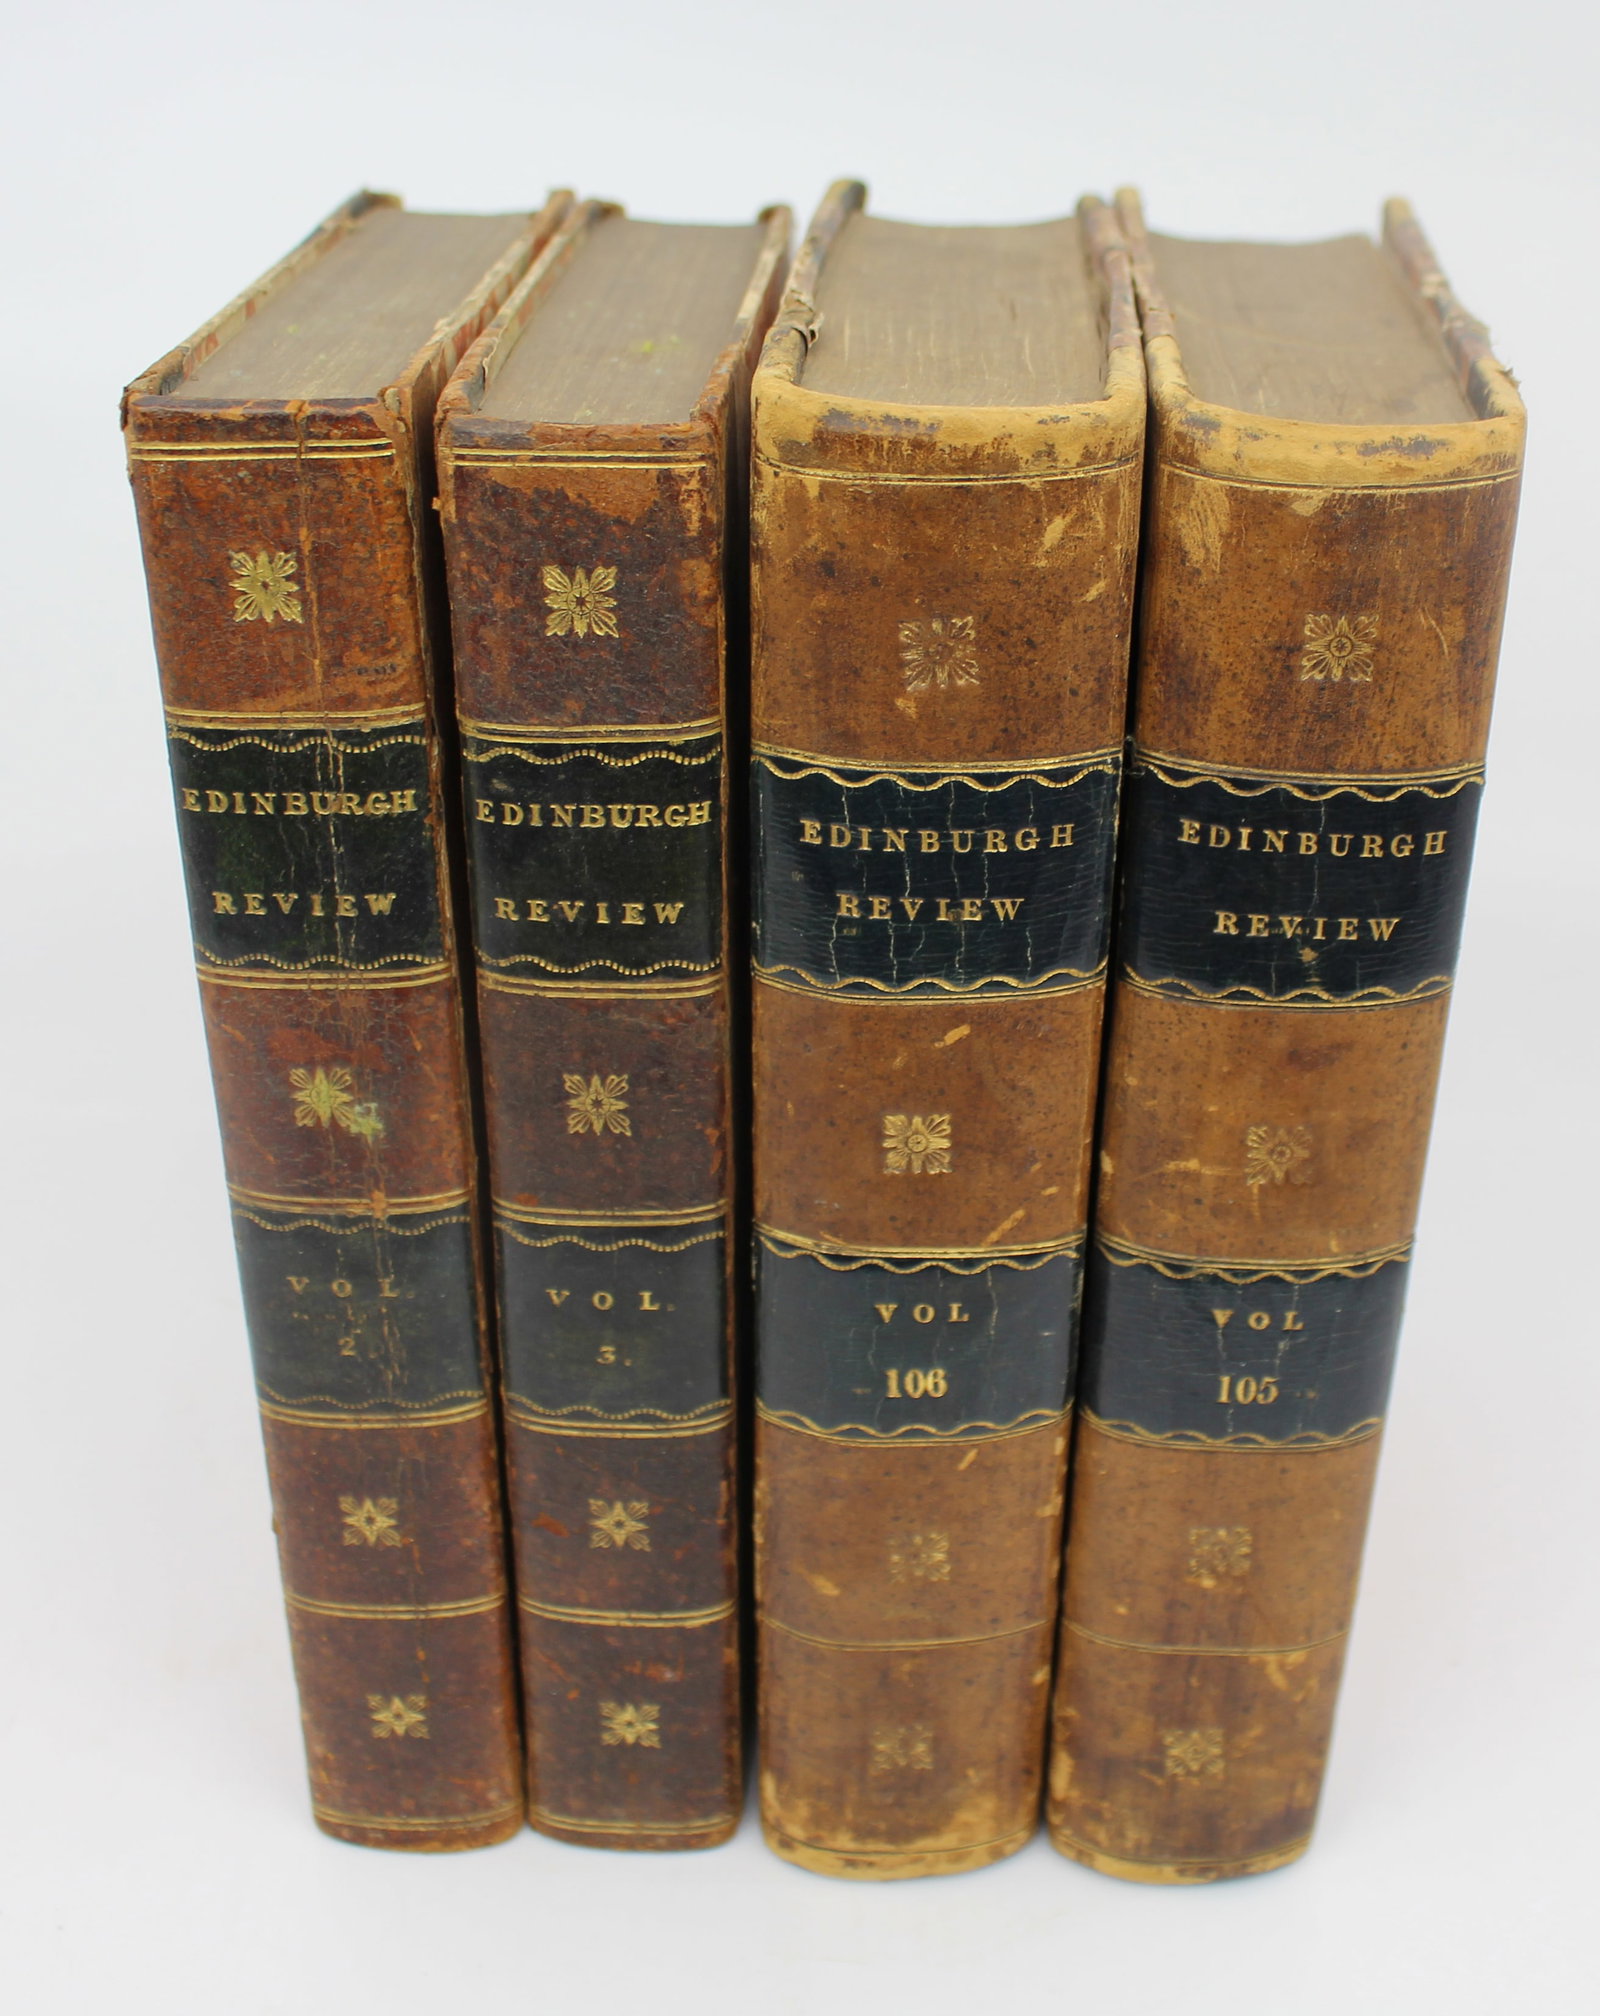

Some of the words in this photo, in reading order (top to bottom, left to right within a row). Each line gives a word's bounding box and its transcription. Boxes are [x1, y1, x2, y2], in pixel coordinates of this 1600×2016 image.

[182, 787, 418, 816] EDINBURGH
[475, 799, 712, 829] EDINBURGH
[799, 818, 1075, 853] EDINBURGH
[1177, 818, 1448, 858] EDINBURGH
[212, 891, 397, 917] REVIEW
[494, 897, 684, 925] REVIEW
[836, 892, 1025, 922] REVIEW
[1213, 910, 1400, 942] REVIEW
[874, 1303, 970, 1324] VOL
[1211, 1309, 1304, 1331] VOL
[884, 1368, 949, 1399] 106
[1216, 1375, 1280, 1405] 105
